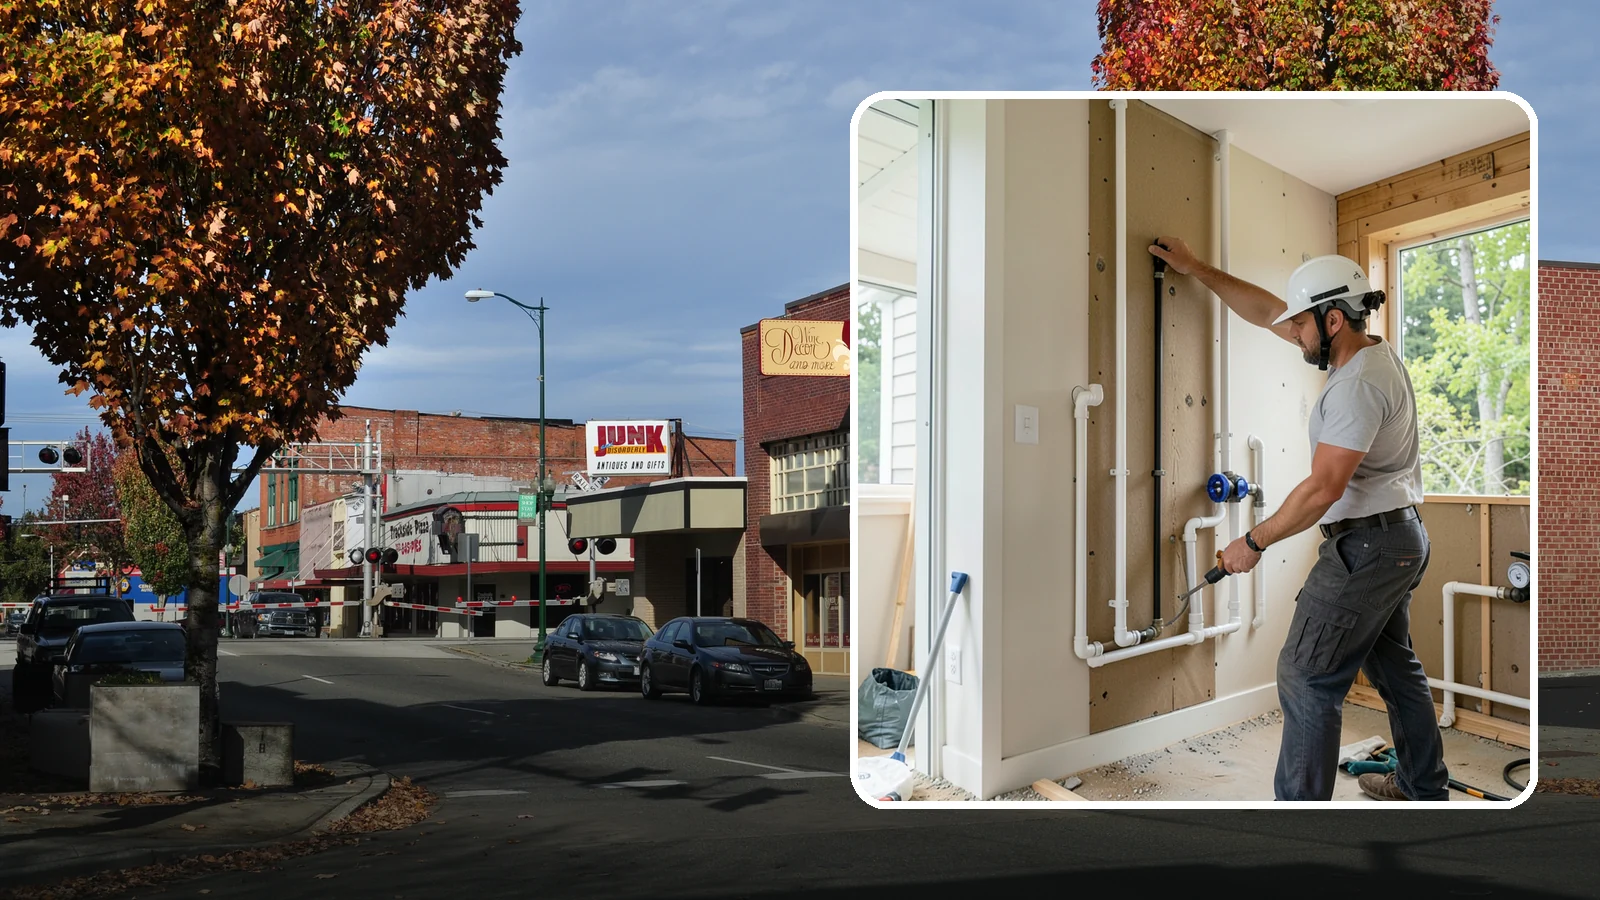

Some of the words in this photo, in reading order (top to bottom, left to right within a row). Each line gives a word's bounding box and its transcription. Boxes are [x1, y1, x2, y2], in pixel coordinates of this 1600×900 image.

[596, 425, 664, 457] JUNK
[597, 461, 628, 470] ANTIQUES
[631, 461, 644, 470] AND
[647, 460, 665, 469] GIFTS
[414, 520, 428, 534] Pizza
